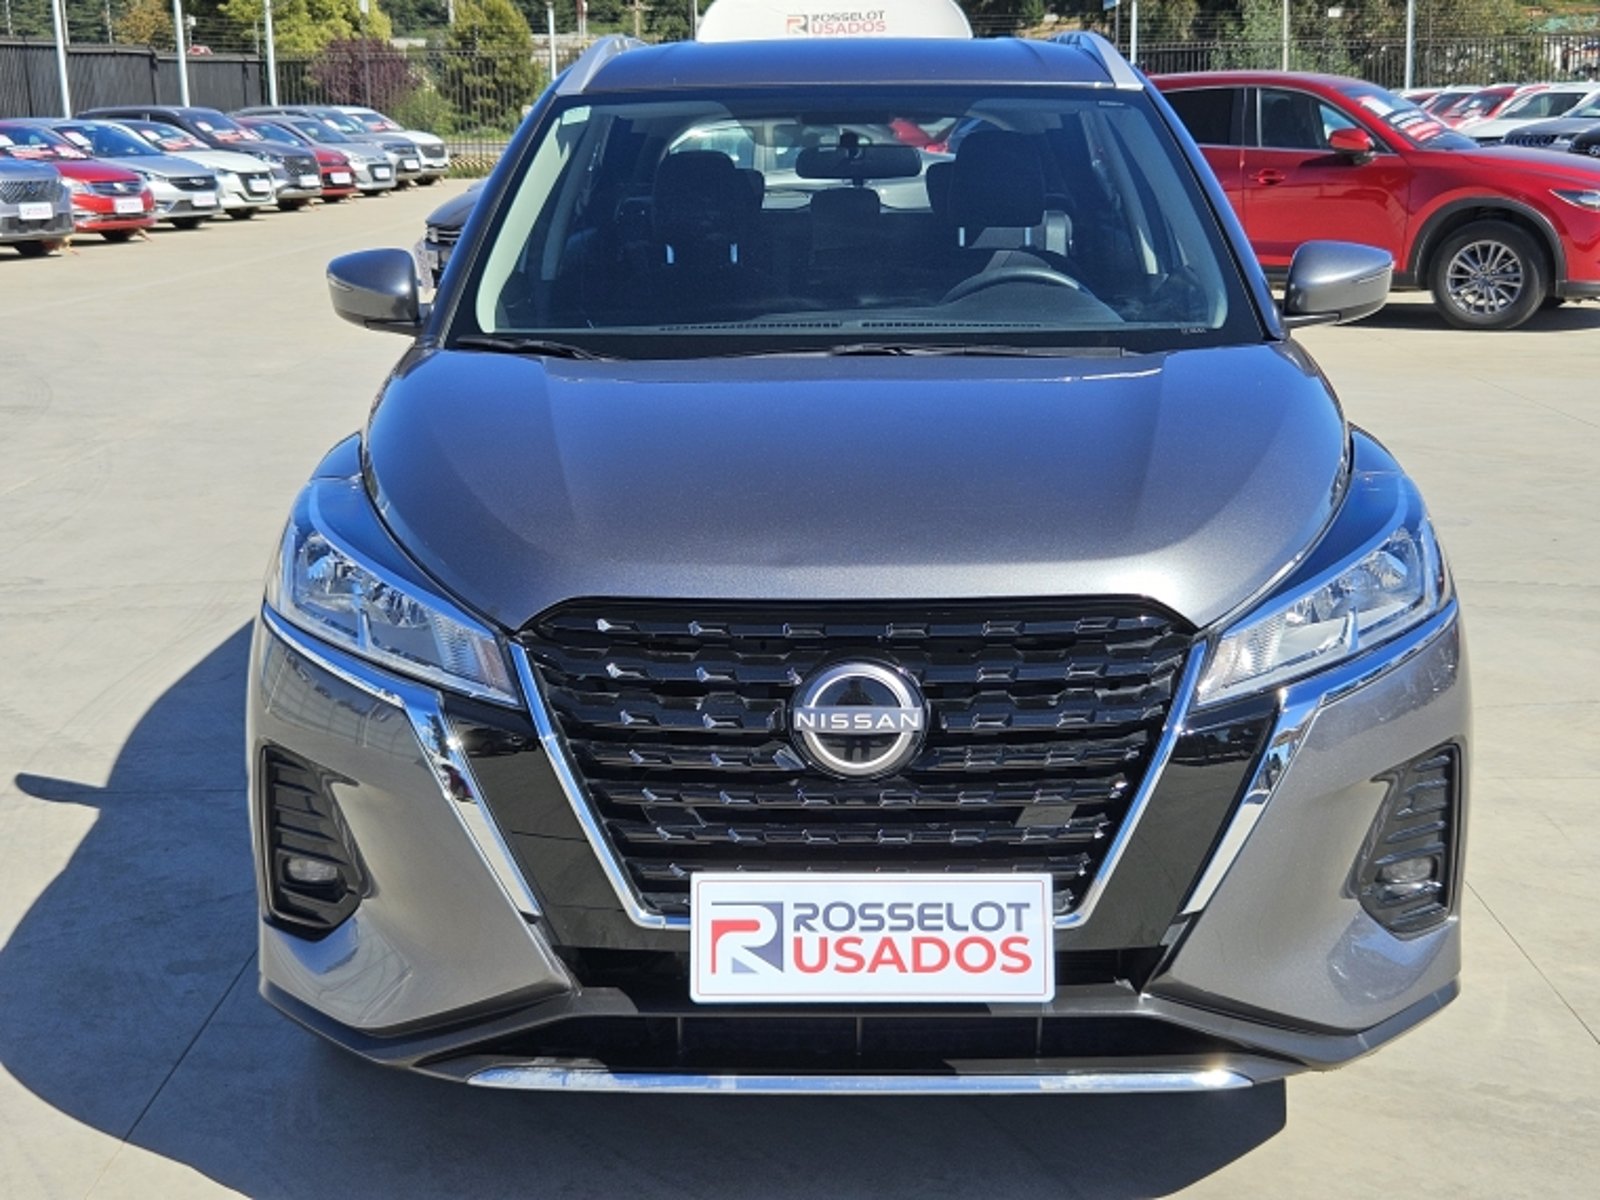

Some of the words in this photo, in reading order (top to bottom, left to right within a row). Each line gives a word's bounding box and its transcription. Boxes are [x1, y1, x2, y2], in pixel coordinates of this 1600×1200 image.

[812, 10, 885, 22] ROSSELOT
[812, 21, 886, 34] USADOS
[796, 713, 919, 729] NISSAN
[793, 901, 1030, 932] ROSSELOT
[793, 936, 1032, 974] USADOS
